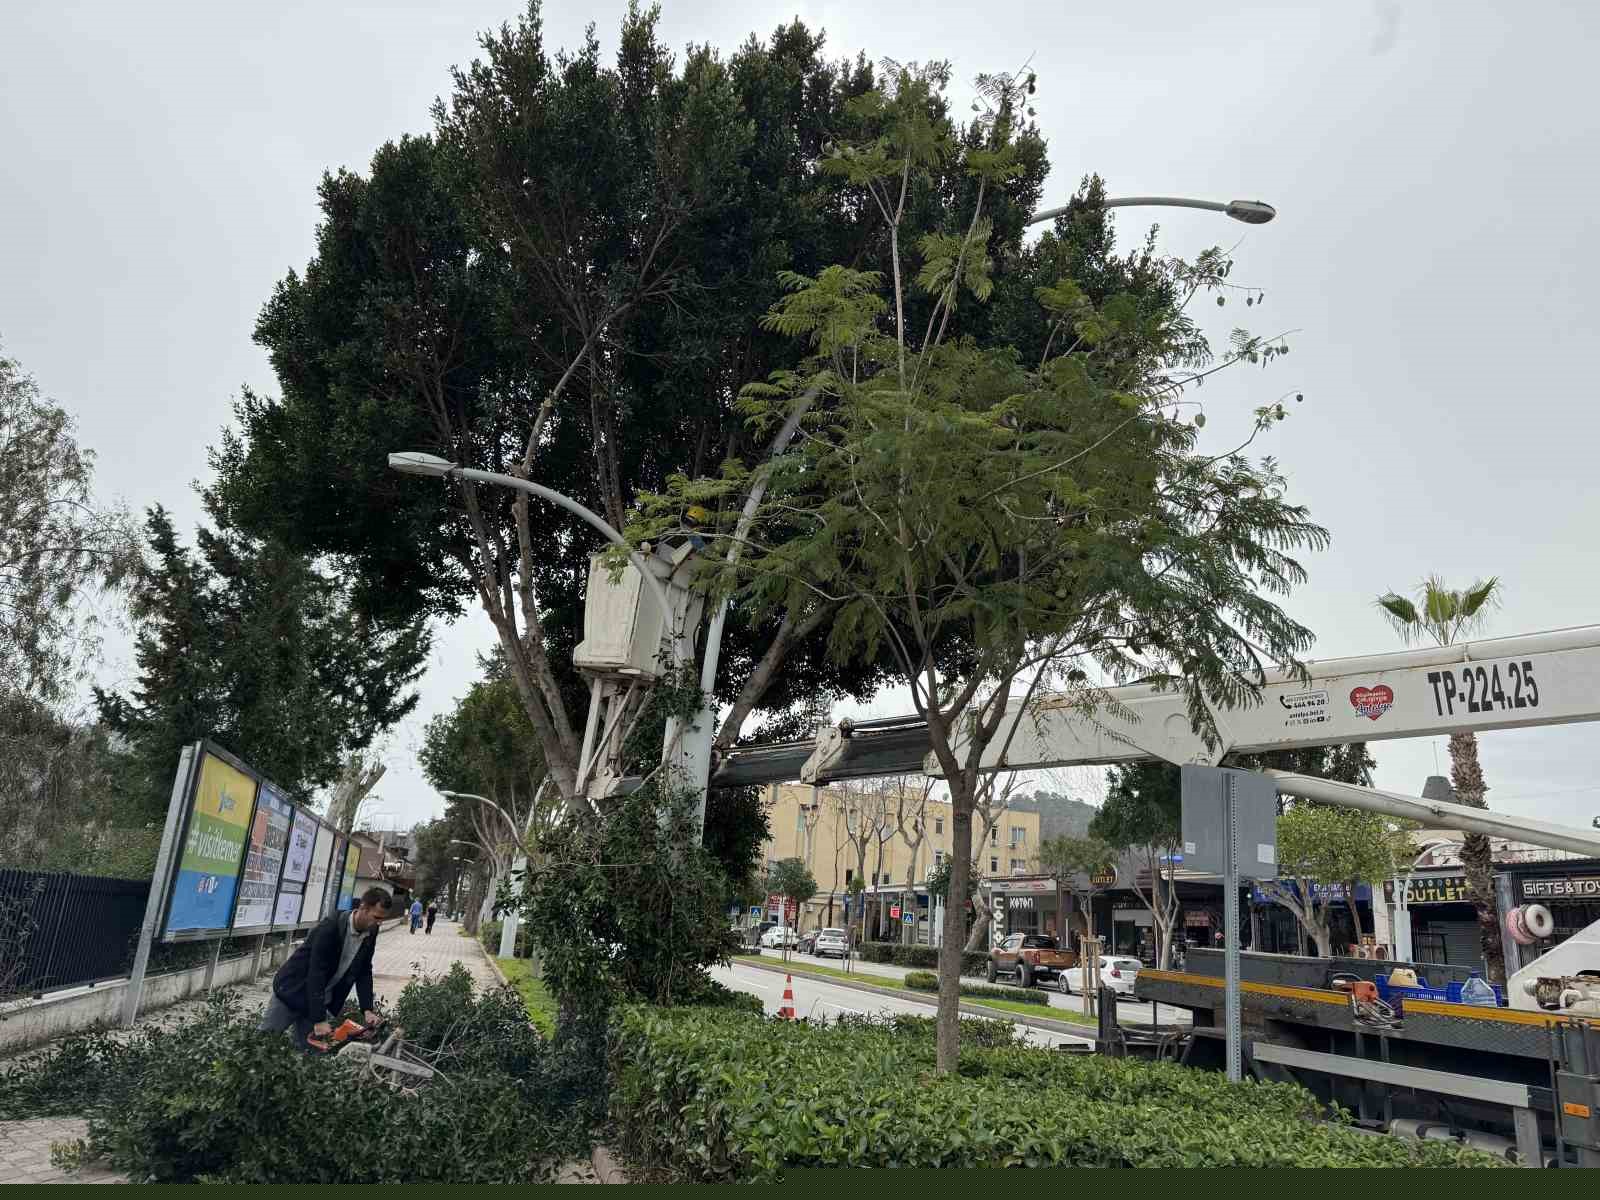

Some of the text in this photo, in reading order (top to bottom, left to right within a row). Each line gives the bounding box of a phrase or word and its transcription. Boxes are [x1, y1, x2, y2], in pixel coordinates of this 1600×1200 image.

[1427, 660, 1539, 716] TP-224.25
[1406, 887, 1465, 901] OUTLET
[993, 897, 1004, 948] OTON
